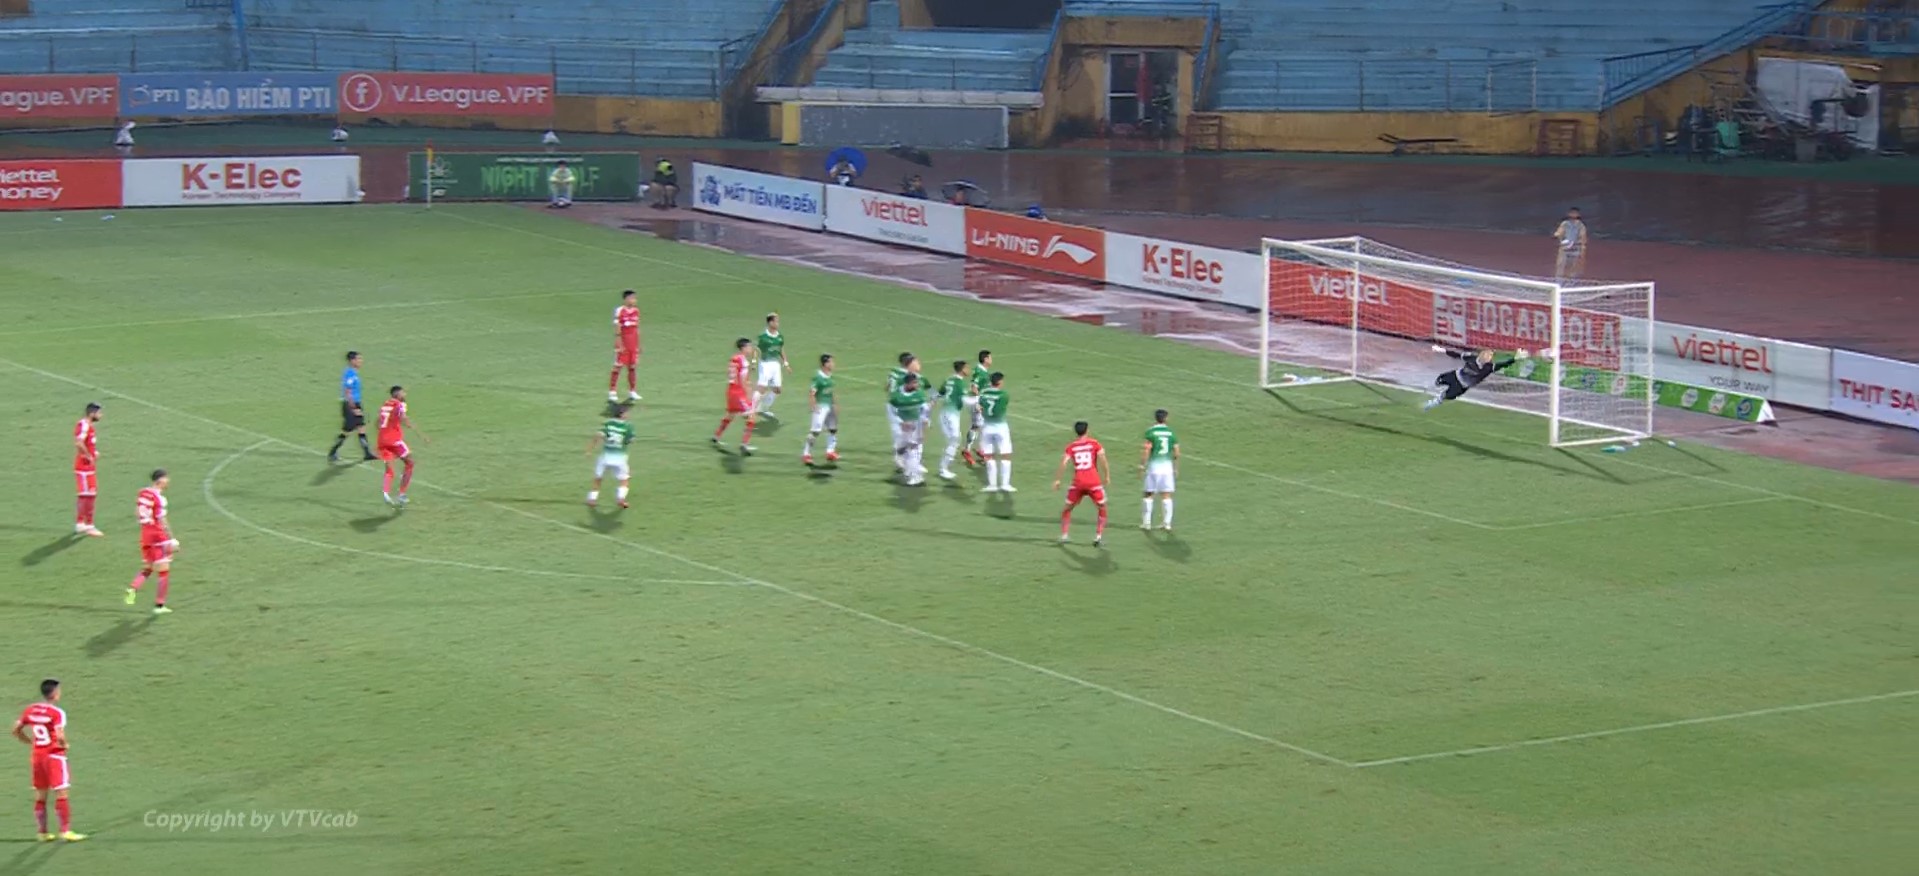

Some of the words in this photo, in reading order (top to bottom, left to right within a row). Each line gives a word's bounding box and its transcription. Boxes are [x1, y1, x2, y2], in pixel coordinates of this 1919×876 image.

[152, 89, 179, 102] PTI
[186, 80, 230, 110] BẢO
[236, 78, 292, 109] HIỂM
[297, 86, 331, 108] PTI
[391, 84, 550, 109] V.League.VPF
[0, 168, 61, 183] iettel
[181, 162, 302, 190] K-Elec
[971, 227, 1040, 255] LI-NING
[1142, 243, 1224, 284] K-Elec
[1469, 300, 1617, 354] JOGAROLA
[1671, 333, 1773, 374] viettel
[1709, 375, 1742, 390] YOUR
[1744, 380, 1770, 393] WAY
[986, 400, 996, 416] 7
[1158, 437, 1169, 455] 3
[1074, 452, 1093, 470] 99
[33, 724, 51, 746] 9
